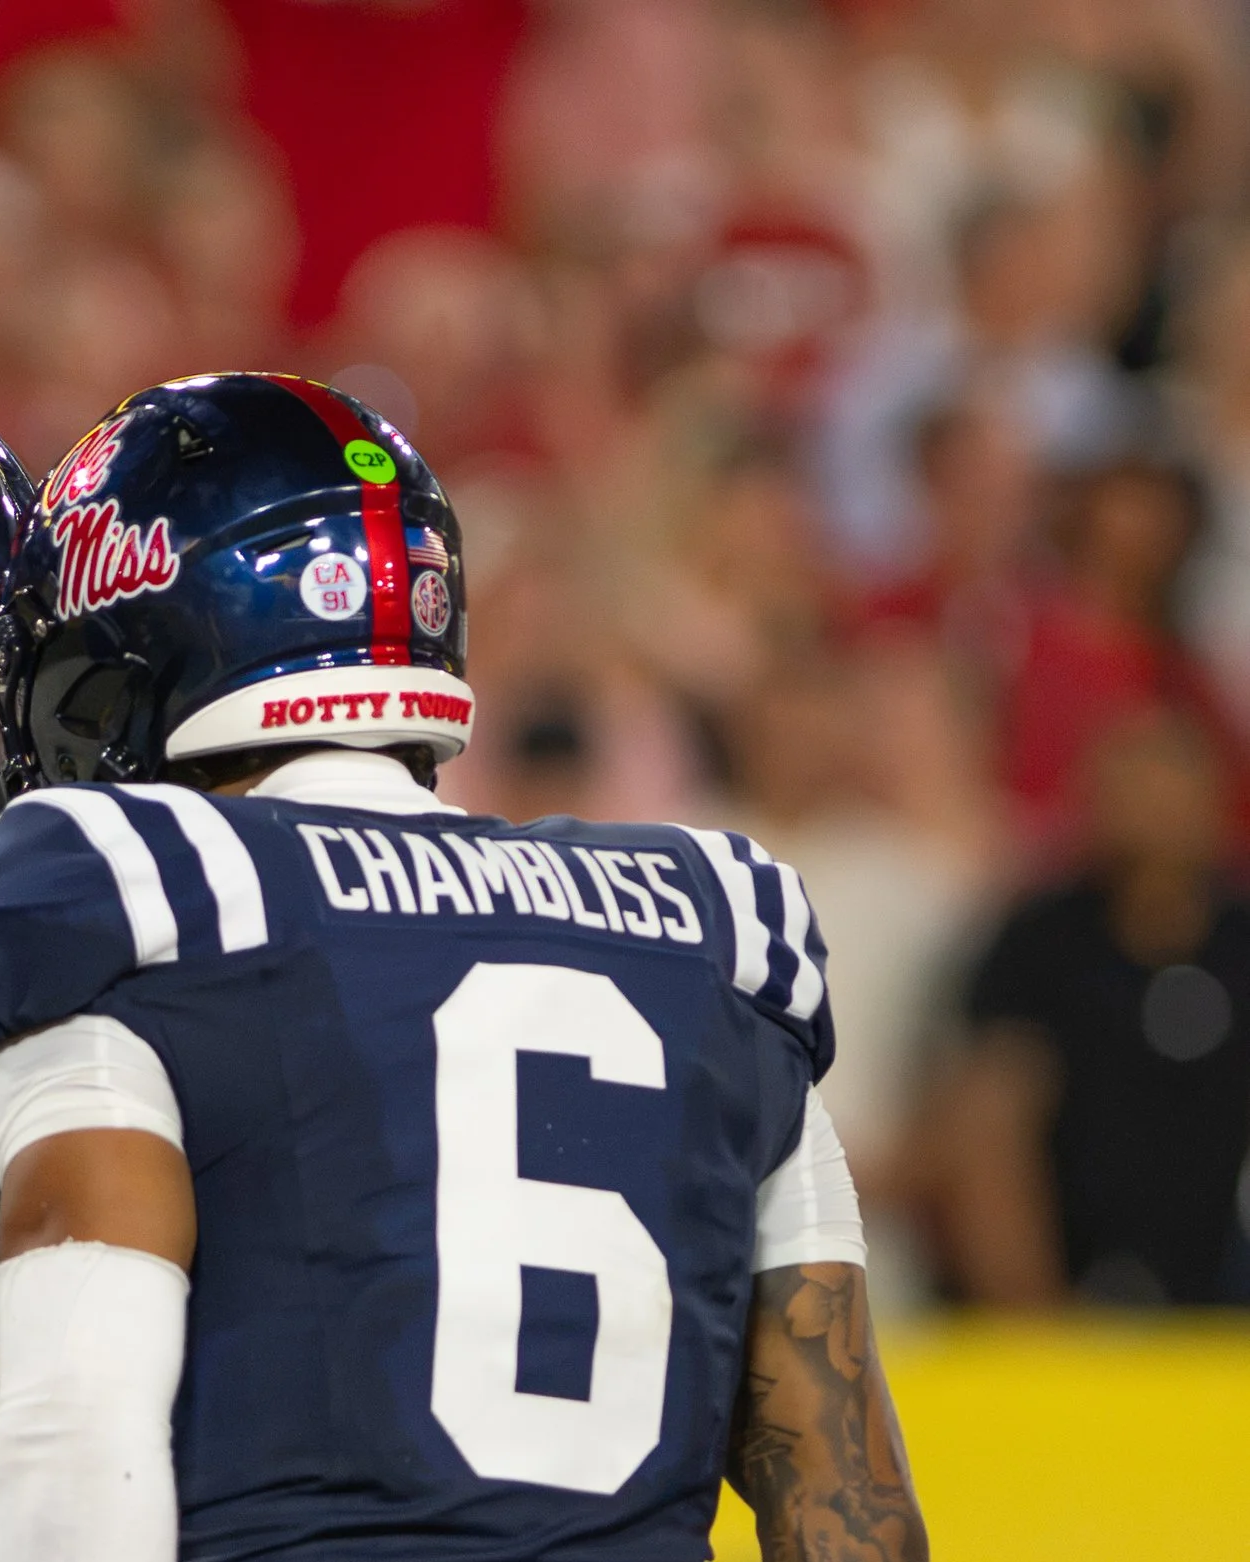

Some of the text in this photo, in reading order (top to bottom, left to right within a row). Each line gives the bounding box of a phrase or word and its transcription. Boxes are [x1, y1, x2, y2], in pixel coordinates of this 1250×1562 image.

[351, 452, 387, 468] C2P
[53, 497, 181, 621] Miss
[315, 563, 351, 584] CA
[323, 592, 350, 611] 91
[261, 693, 390, 729] HOTTY
[296, 823, 703, 945] CHAMBLISS
[430, 962, 673, 1495] 6
